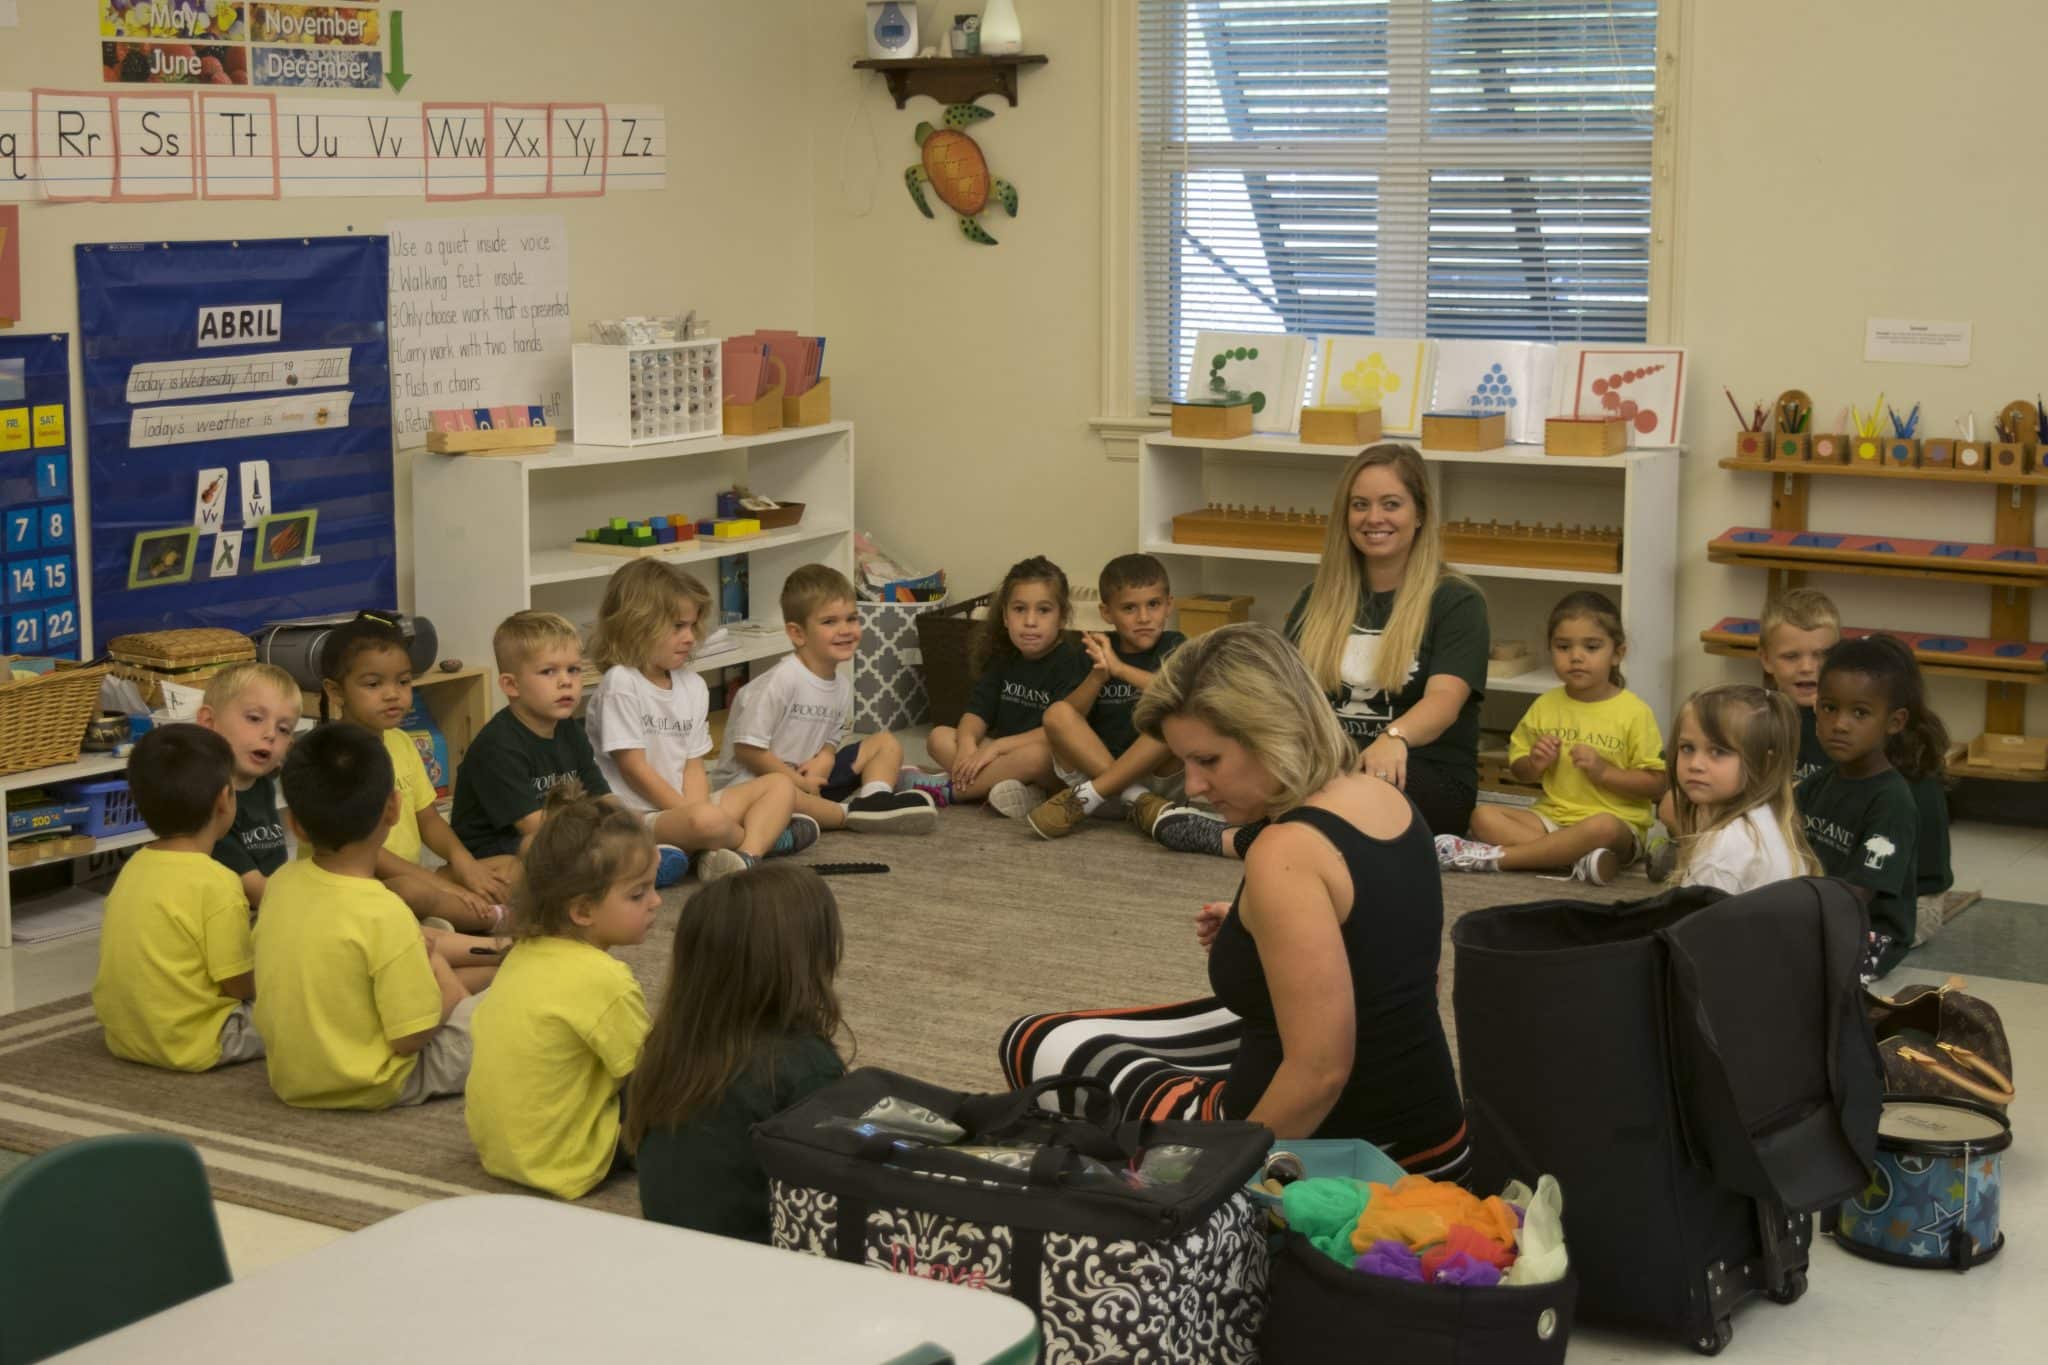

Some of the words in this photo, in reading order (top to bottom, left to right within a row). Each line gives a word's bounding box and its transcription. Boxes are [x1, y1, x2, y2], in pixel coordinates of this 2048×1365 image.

[150, 3, 199, 36] May
[264, 12, 368, 37] November
[150, 48, 202, 76] June
[267, 53, 369, 80] December
[58, 110, 101, 157] Rr
[140, 111, 180, 156] Ss
[219, 112, 257, 157] Tt
[296, 114, 338, 158] Uu
[367, 116, 402, 158] Vv
[426, 117, 486, 158] Ww
[504, 117, 541, 158] Xx
[564, 118, 596, 176] Yy
[621, 119, 653, 157] Zz
[425, 240, 433, 255] a
[438, 228, 469, 266] quiet
[477, 224, 507, 252] inside
[520, 236, 551, 251] voice
[400, 264, 448, 301] Walking
[456, 263, 483, 289] feet
[199, 308, 279, 341] ABRIL
[425, 299, 457, 326] choose
[463, 296, 489, 323] work
[493, 295, 518, 321] that
[530, 291, 569, 328] presented
[400, 336, 427, 369] Carry
[430, 334, 456, 361] work
[460, 331, 481, 358] with
[484, 331, 507, 357] two
[132, 370, 163, 400] Today
[181, 366, 238, 393] Wednesday
[243, 363, 274, 392] April
[316, 357, 345, 379] 2017
[433, 377, 444, 395] in
[449, 368, 482, 393] chairs
[197, 407, 254, 433] weather
[47, 463, 57, 488] 1
[15, 517, 29, 543] 7
[50, 512, 64, 538] 8
[12, 567, 36, 594] 14
[45, 563, 67, 589] 15
[16, 618, 38, 645] 21
[47, 611, 75, 639] 22
